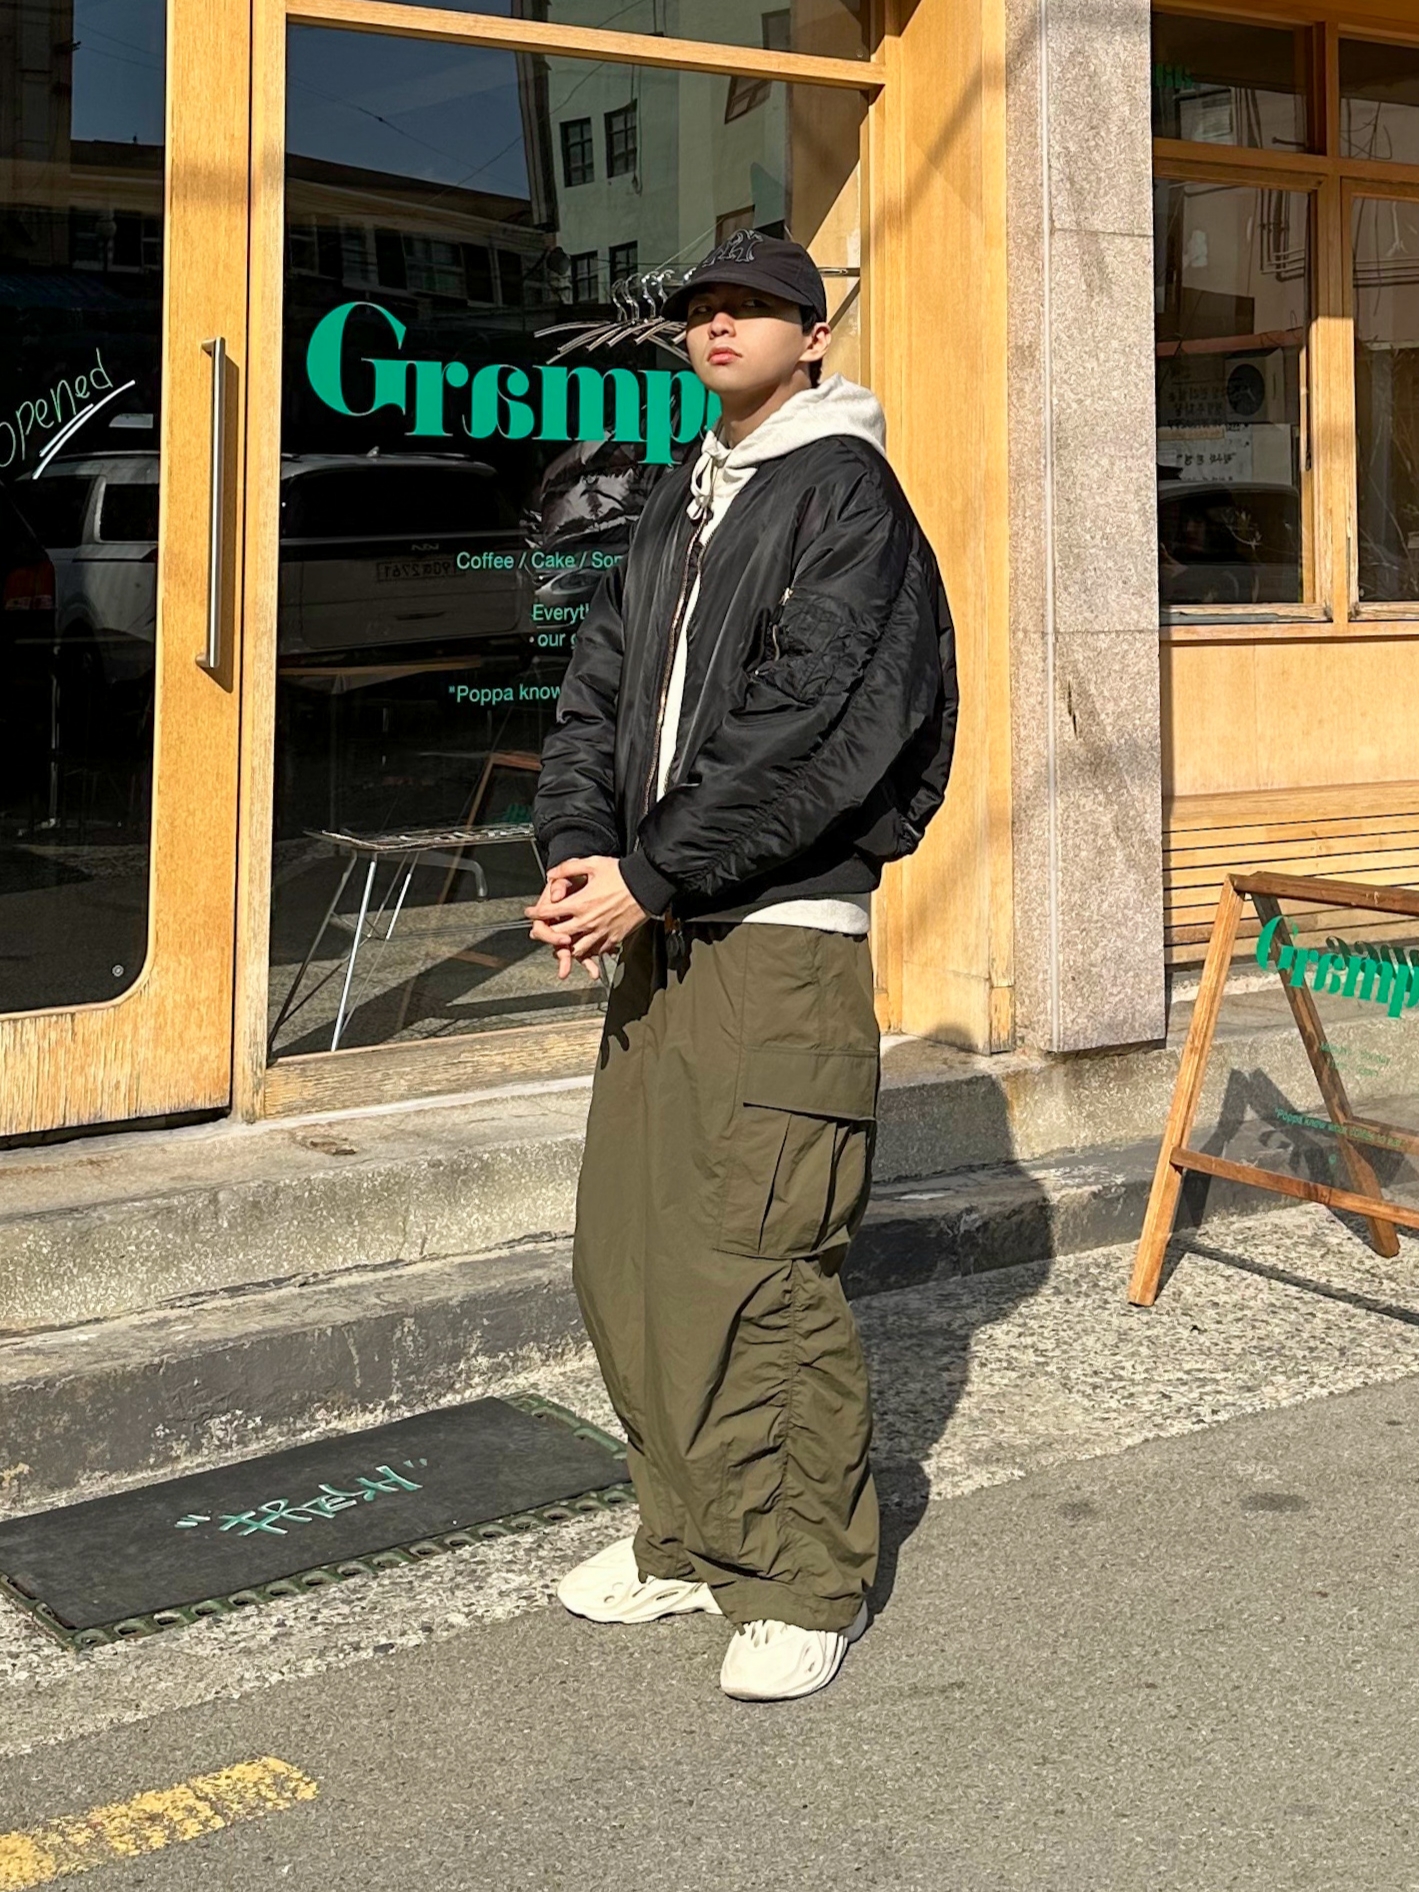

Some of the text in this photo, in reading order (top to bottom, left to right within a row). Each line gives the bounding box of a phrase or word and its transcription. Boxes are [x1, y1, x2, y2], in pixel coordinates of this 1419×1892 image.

[457, 551, 515, 570] Coffee
[531, 551, 576, 569] Cake
[537, 633, 566, 648] our
